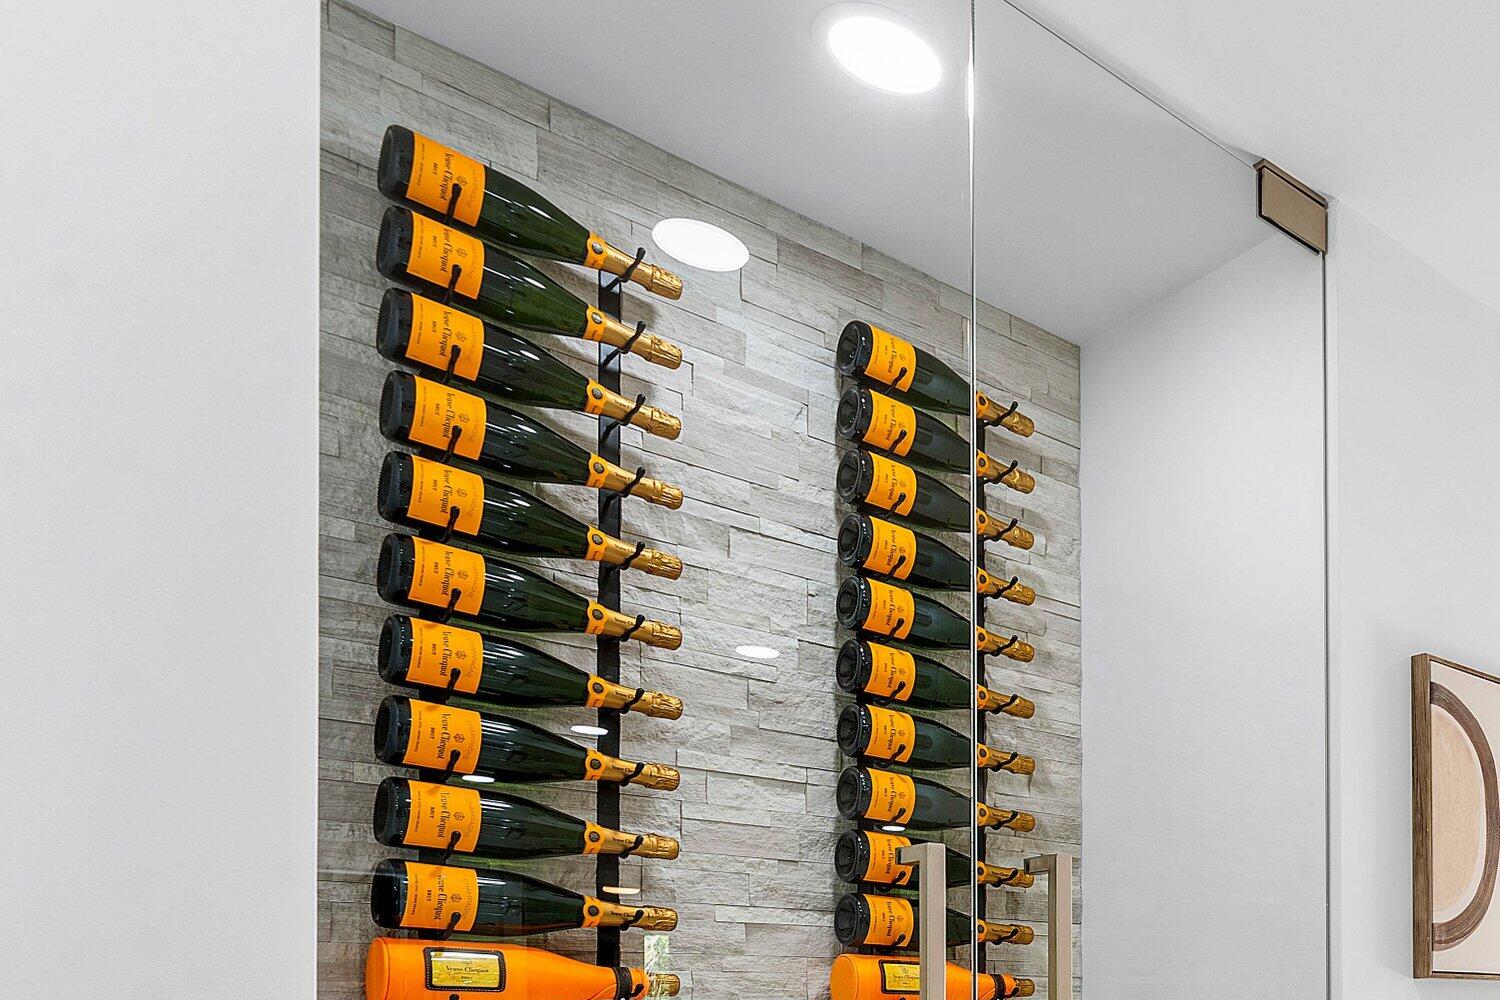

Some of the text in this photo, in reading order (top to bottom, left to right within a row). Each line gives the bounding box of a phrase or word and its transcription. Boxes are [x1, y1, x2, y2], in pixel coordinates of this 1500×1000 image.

[437, 793, 450, 838] Veuve Clicquot
[433, 874, 447, 920] Veuve Clicquot
